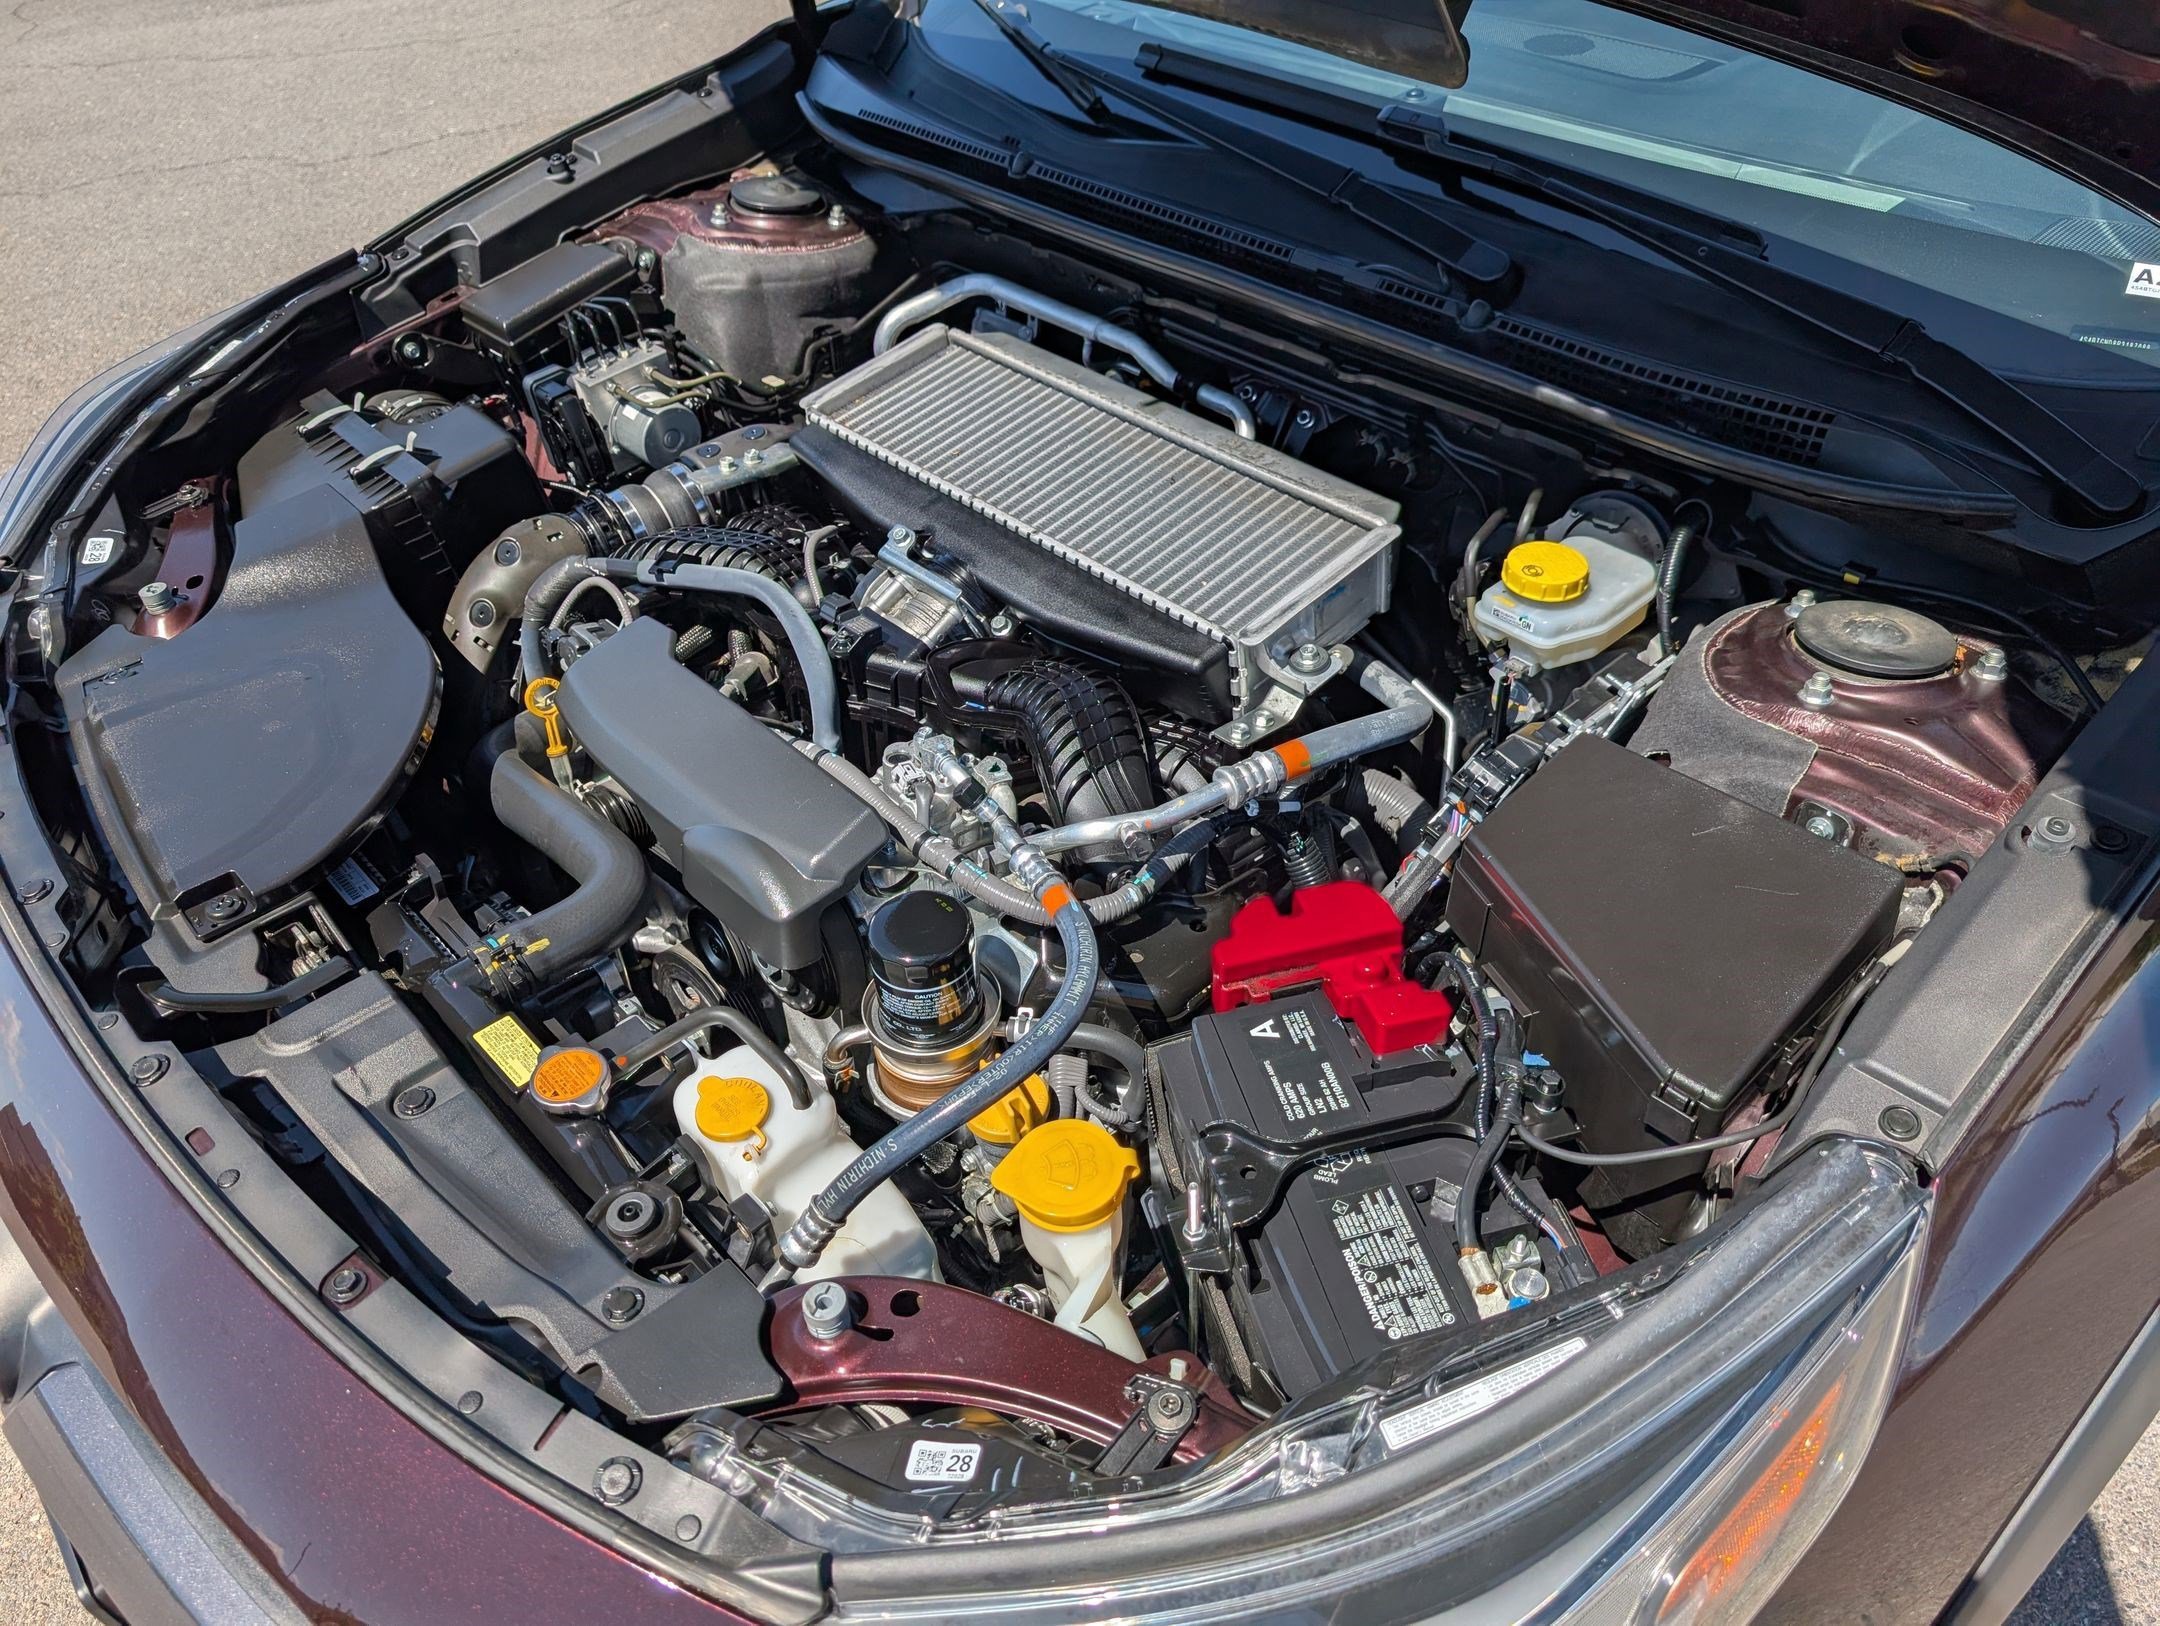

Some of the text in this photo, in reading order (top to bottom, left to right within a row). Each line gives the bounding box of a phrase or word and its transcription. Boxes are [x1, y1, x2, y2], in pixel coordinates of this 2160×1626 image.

[2133, 268, 2160, 286] A
[88, 552, 102, 562] 28
[914, 992, 942, 1000] CAUTION
[1249, 1019, 1281, 1039] A
[1263, 1060, 1295, 1120] COLD CRANKING AMPS
[1296, 1082, 1306, 1095] SIZE
[1318, 1079, 1327, 1087] AH
[1320, 1061, 1349, 1108] 82110AN00B
[1282, 1081, 1305, 1118] 620 AMPS
[1301, 1095, 1316, 1115] GROUP
[1313, 1097, 1327, 1113] LN2
[1325, 1094, 1338, 1110] 20HR
[1313, 1174, 1338, 1185] PLOMB
[1317, 1168, 1338, 1179] LEAD
[1342, 1248, 1380, 1321] DANGER/POISON
[945, 1454, 973, 1473] 28
